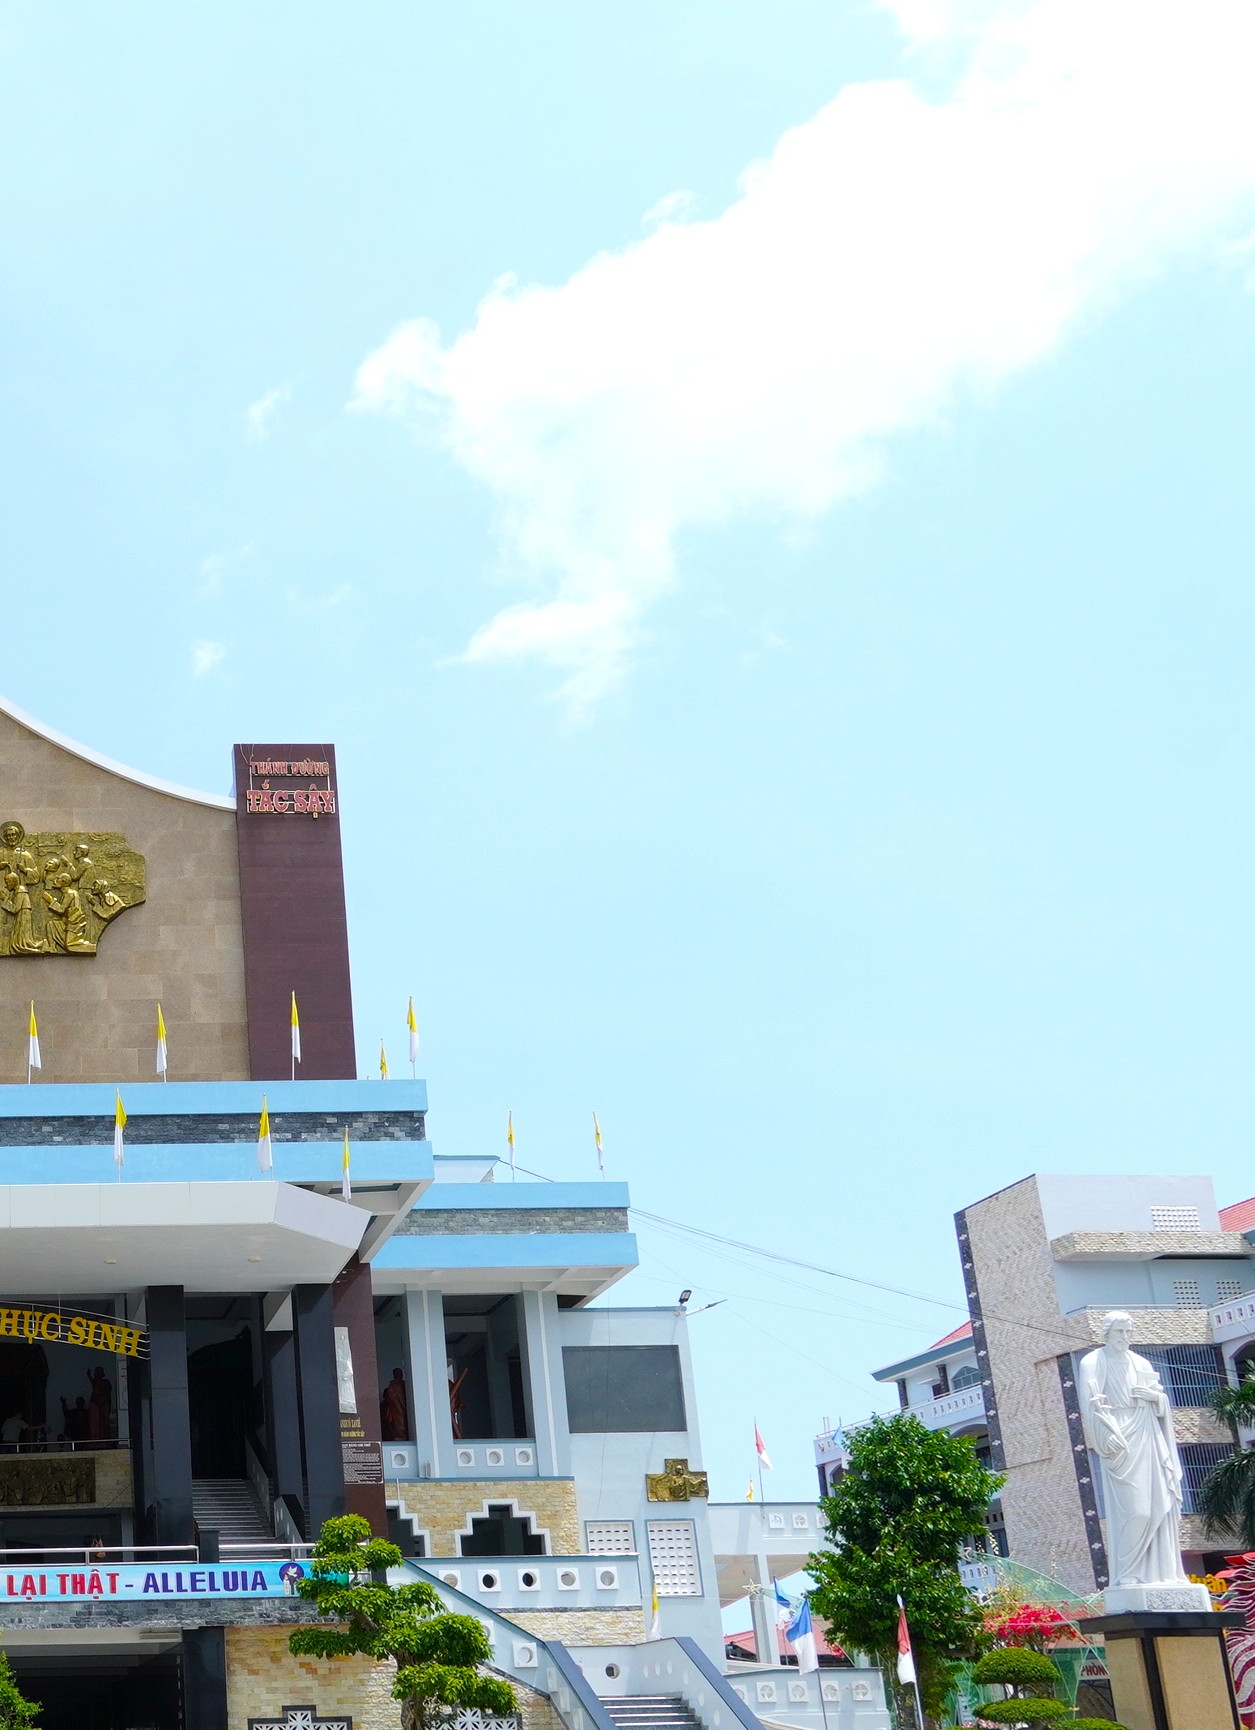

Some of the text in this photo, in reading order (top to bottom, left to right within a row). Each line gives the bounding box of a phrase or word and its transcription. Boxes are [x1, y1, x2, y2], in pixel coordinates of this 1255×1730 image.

[250, 758, 288, 776] THÁNH
[247, 779, 335, 818] TẮC SẬY
[67, 1316, 142, 1357] SINH
[6, 1573, 47, 1601] LẠI
[56, 1568, 120, 1599] THẬT
[143, 1570, 268, 1593] ALLELUIA
